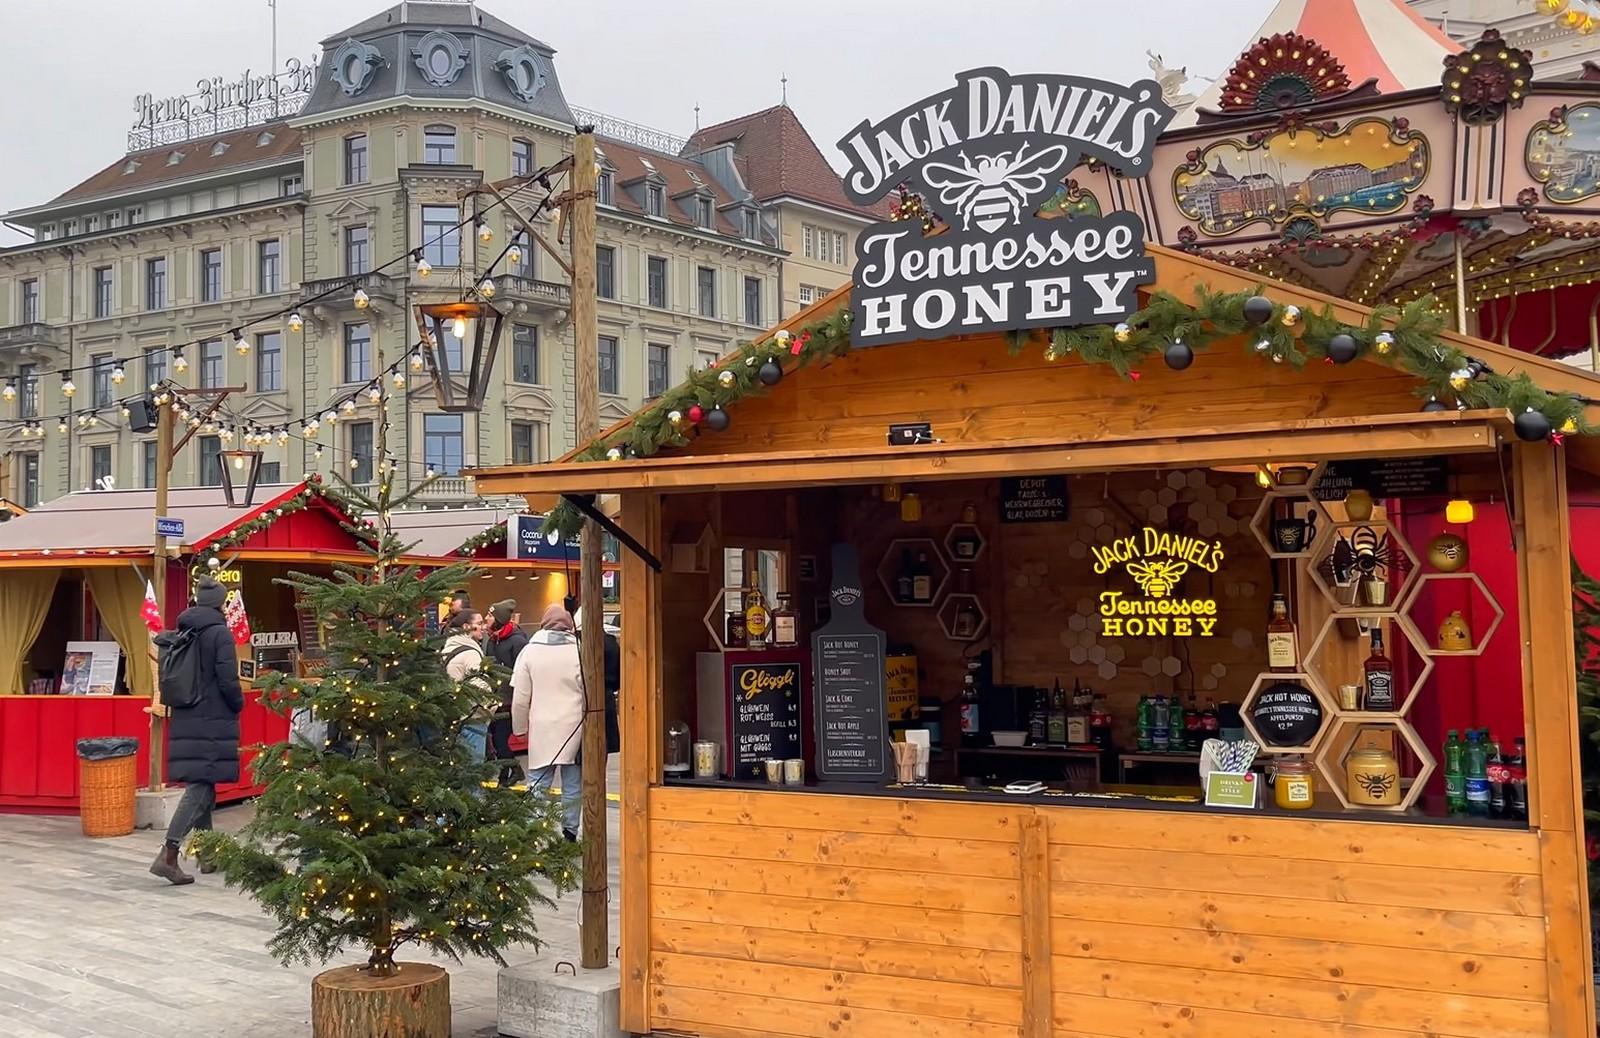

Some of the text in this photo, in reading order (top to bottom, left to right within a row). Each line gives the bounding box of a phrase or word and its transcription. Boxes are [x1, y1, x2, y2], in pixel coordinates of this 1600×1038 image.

[850, 76, 1162, 195] JACK DANIEL'S
[862, 225, 1134, 288] Tennessee
[860, 271, 1135, 336] HONEY
[1091, 527, 1224, 574] JACK DANIEL'S
[1099, 591, 1217, 616] Tennessee
[1101, 618, 1217, 636] HONEY
[250, 631, 298, 647] CHOLERA
[741, 669, 794, 700] Glöggli
[1259, 692, 1312, 705] JACK HOT HONEY
[740, 704, 770, 714] GLÜHWEIN
[755, 713, 774, 721] WEISS
[740, 734, 770, 744] GLÜHWEIN
[740, 744, 751, 752] MIT
